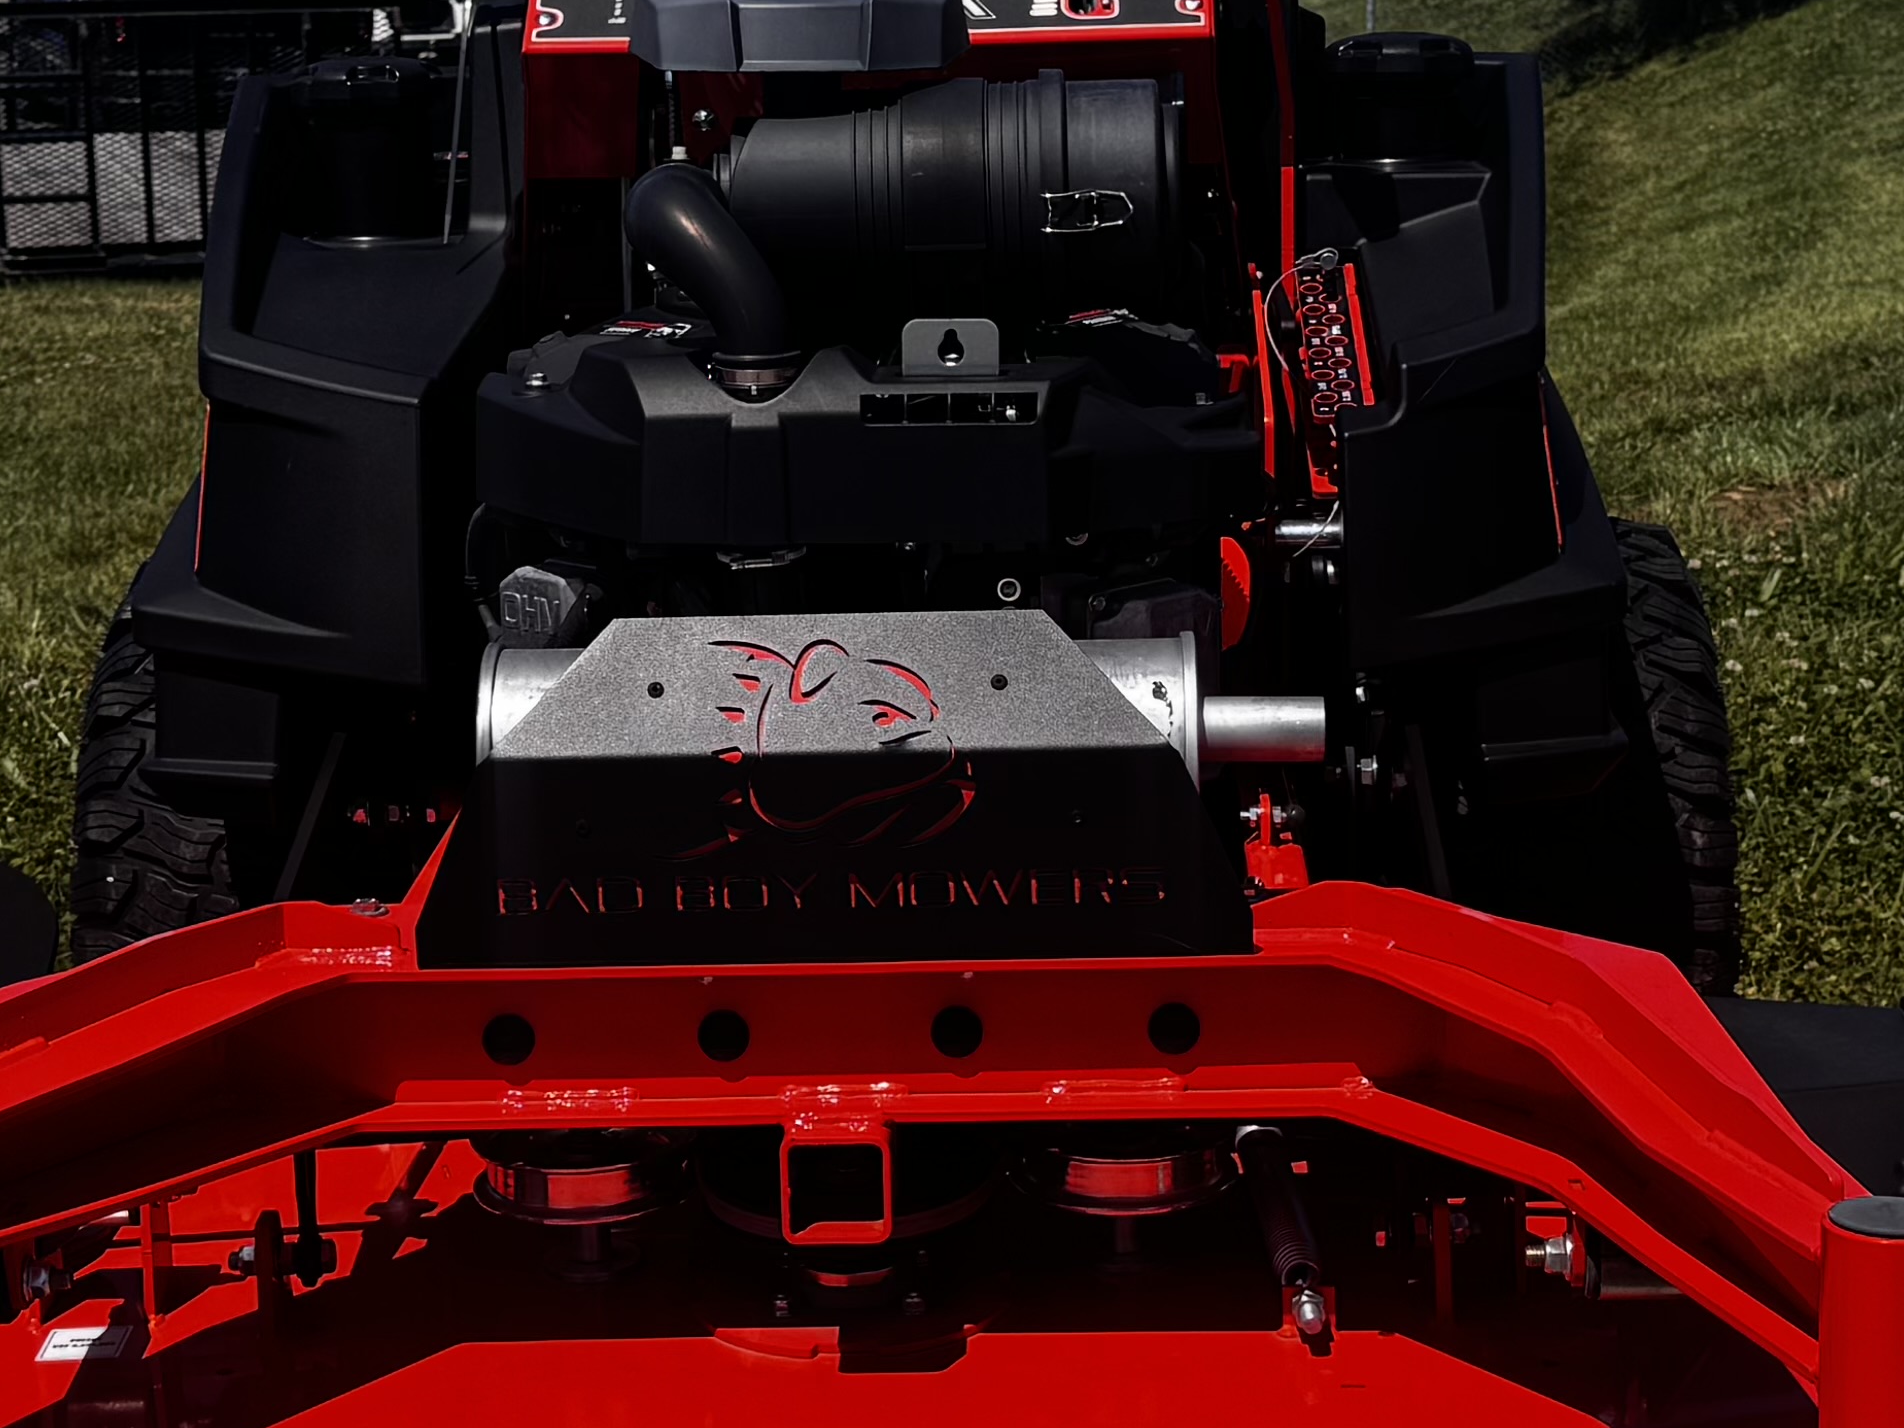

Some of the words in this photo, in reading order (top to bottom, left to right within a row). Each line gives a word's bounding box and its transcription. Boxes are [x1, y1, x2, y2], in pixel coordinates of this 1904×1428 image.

[500, 590, 561, 636] OHV
[495, 877, 644, 915] BAD
[675, 874, 817, 912] BOY
[848, 866, 1166, 909] MOWERS
